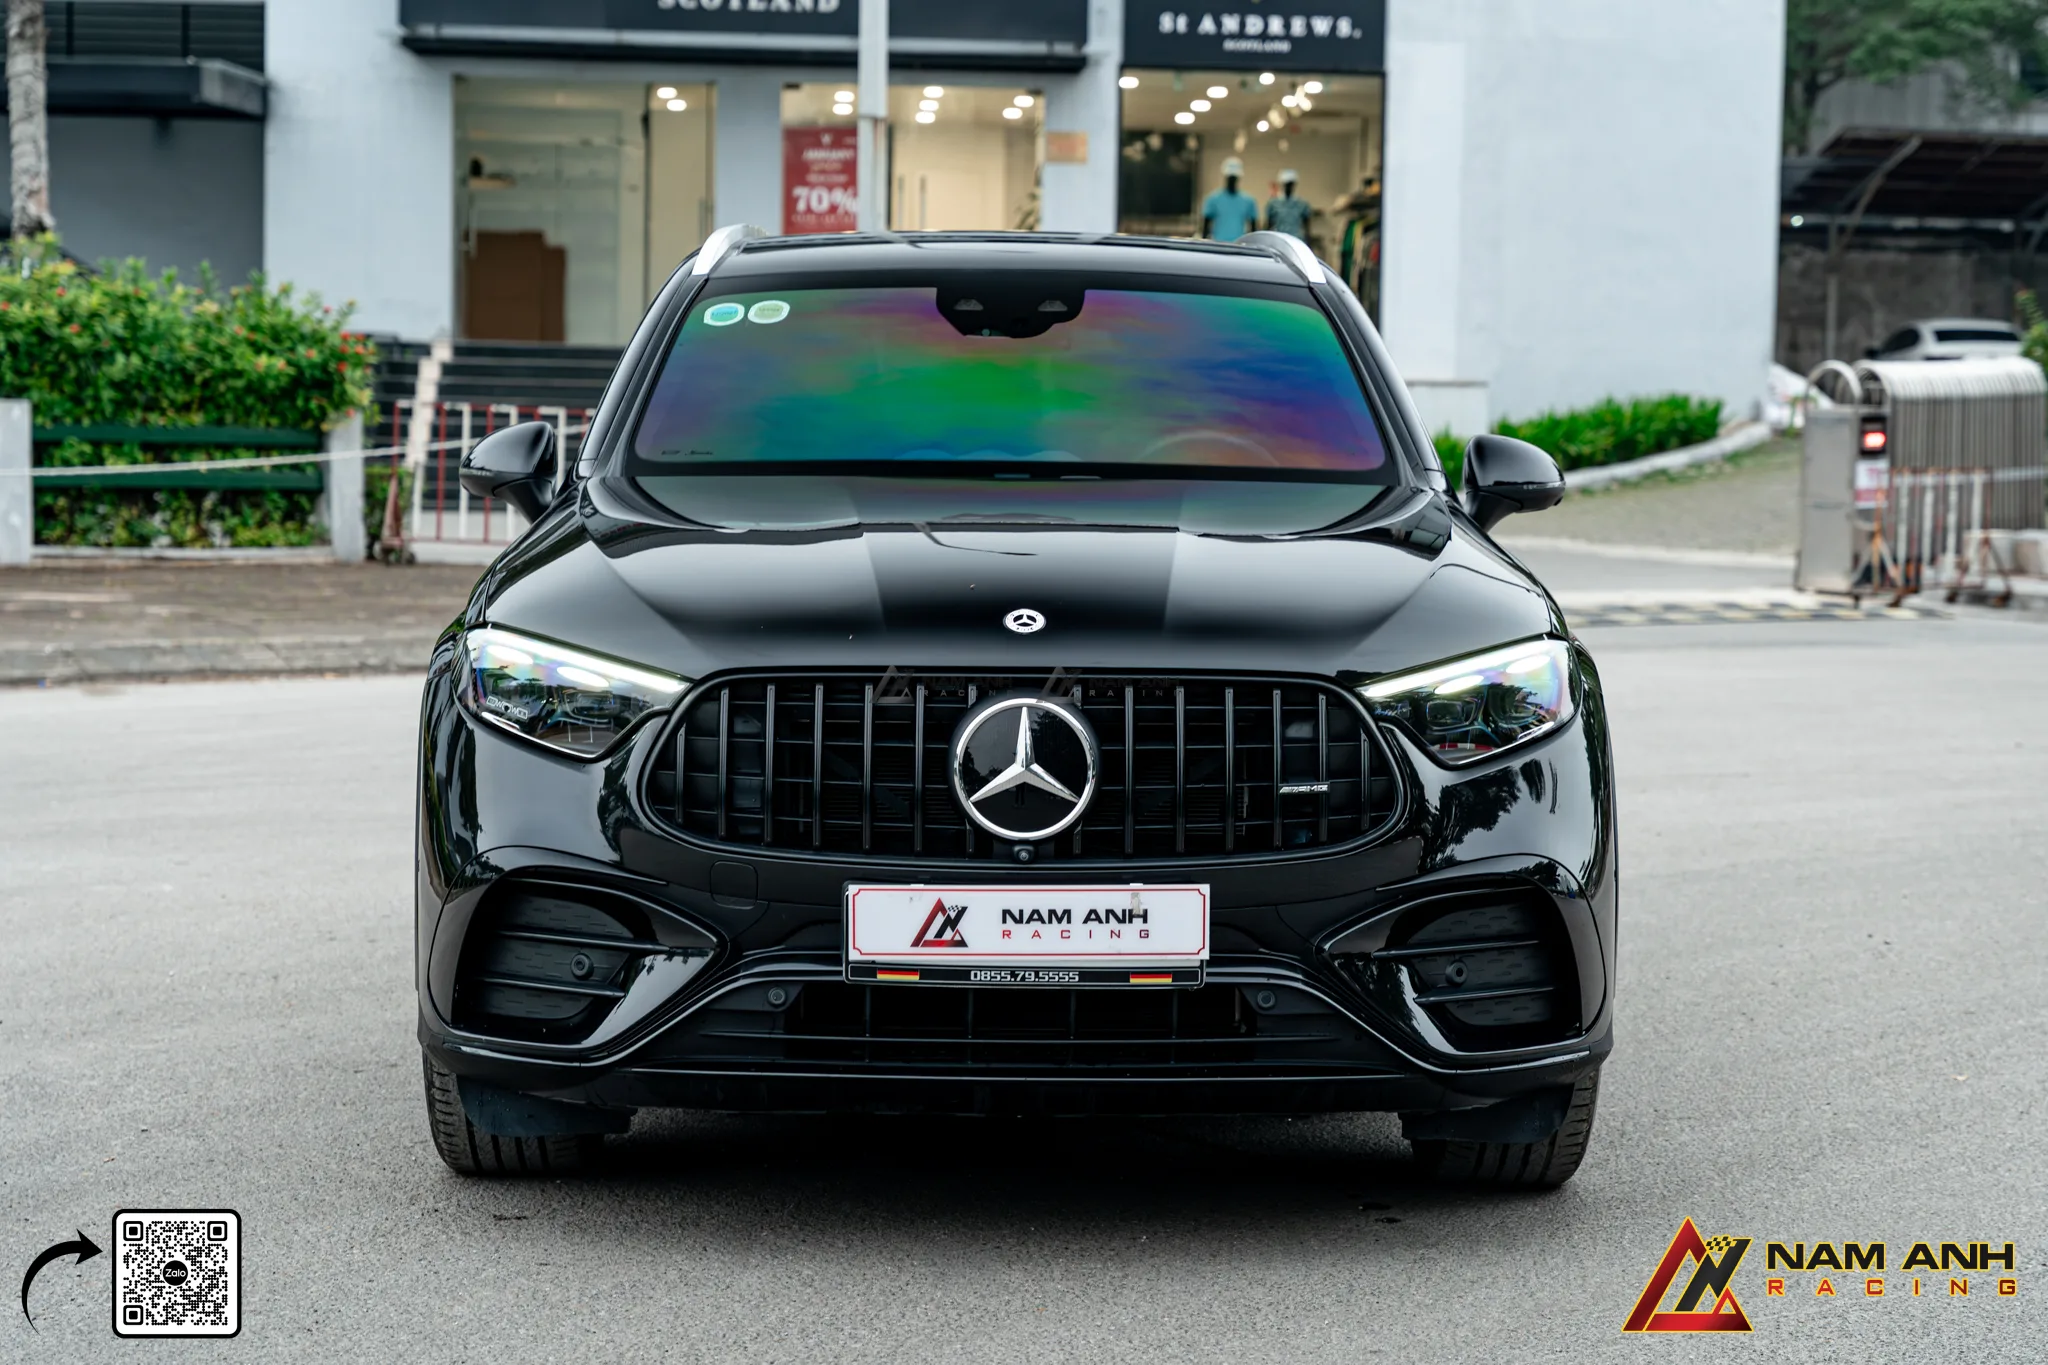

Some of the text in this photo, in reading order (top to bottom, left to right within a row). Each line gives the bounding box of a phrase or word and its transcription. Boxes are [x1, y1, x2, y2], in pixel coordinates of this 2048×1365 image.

[1158, 11, 1363, 39] St ANDREWS.
[792, 185, 859, 214] 70%
[1001, 908, 1148, 925] NAM ANH
[1001, 929, 1150, 940] RACING
[970, 970, 1080, 982] 0855.79.5555
